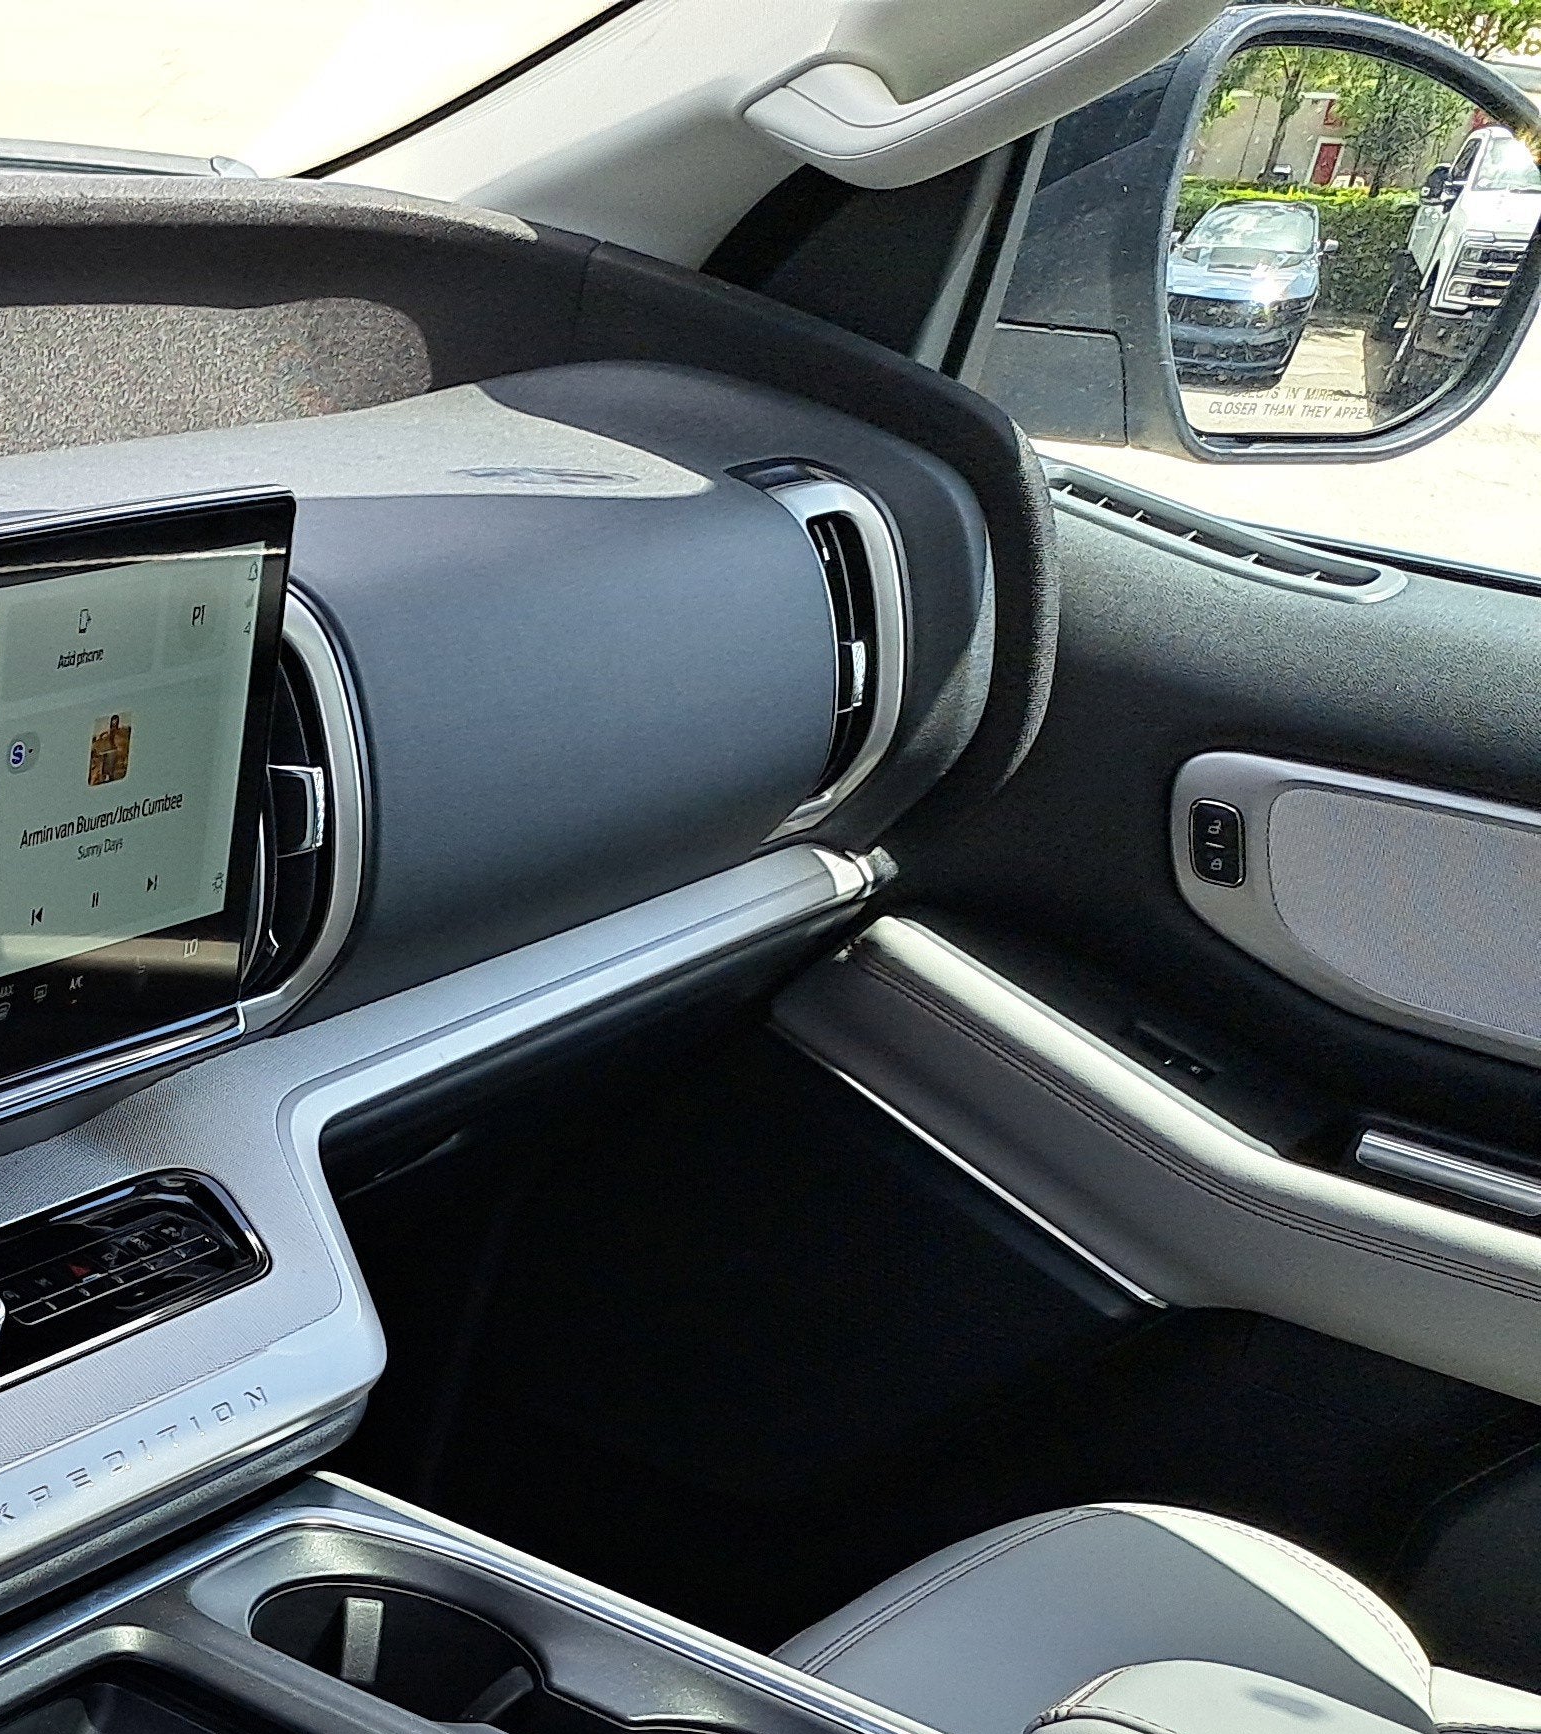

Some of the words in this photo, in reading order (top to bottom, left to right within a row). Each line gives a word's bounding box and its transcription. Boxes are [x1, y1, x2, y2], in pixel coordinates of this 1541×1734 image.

[1208, 401, 1258, 415] CLOSER
[1262, 403, 1296, 417] THAN
[1301, 405, 1331, 418] THEY
[1334, 407, 1380, 420] APPEAR
[57, 650, 75, 669] Add
[20, 825, 53, 849] Armin
[55, 821, 75, 840] van
[141, 793, 184, 817] Cumbee
[77, 840, 102, 861] Sunny
[104, 838, 124, 855] Days
[69, 976, 84, 992] A/C
